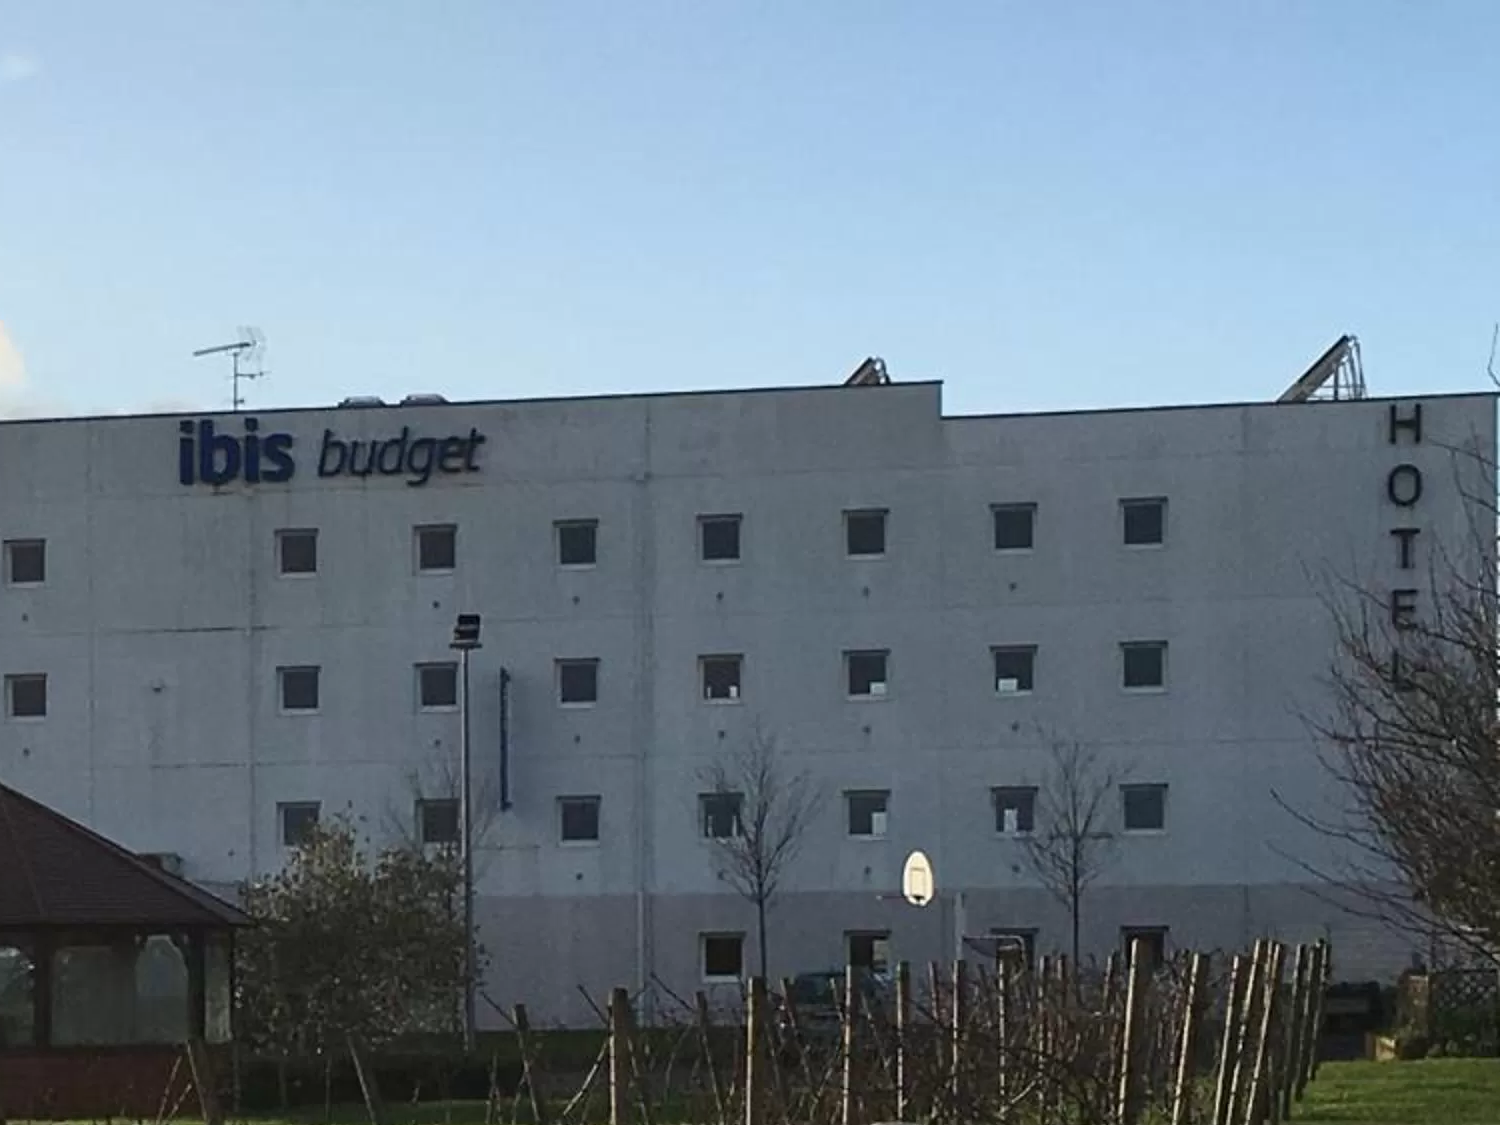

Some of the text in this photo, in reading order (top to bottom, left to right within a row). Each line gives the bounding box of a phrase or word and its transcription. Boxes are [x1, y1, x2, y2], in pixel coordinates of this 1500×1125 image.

[179, 417, 486, 487] ibis budget
[1387, 403, 1423, 692] HOTEL
